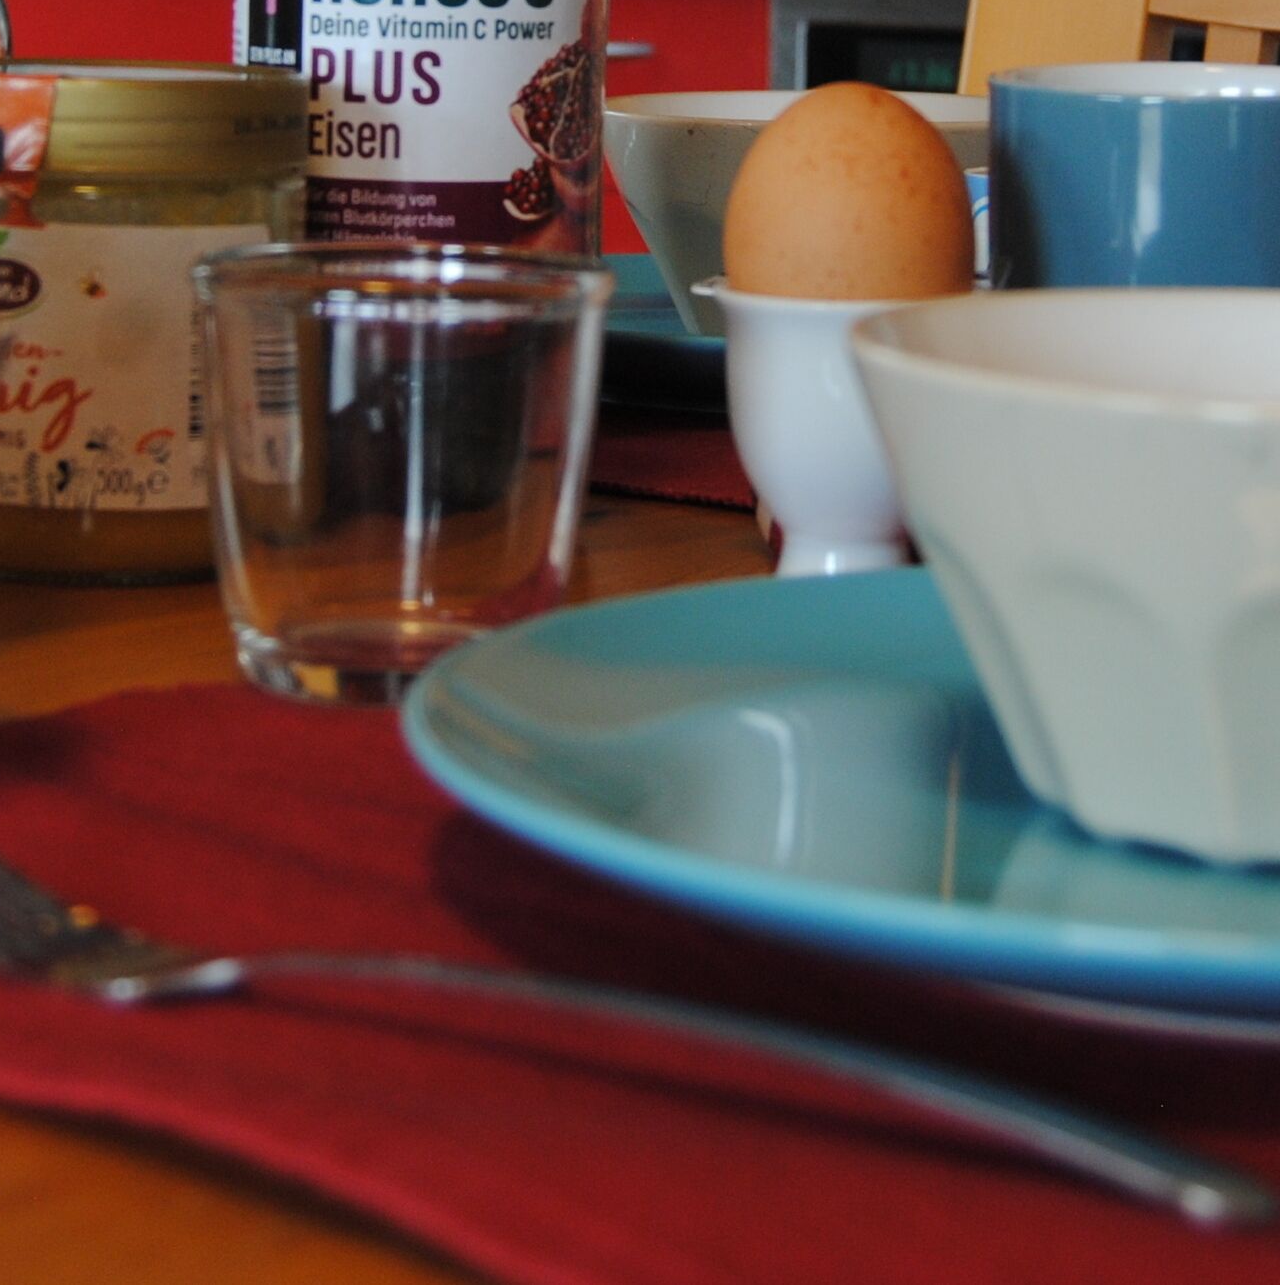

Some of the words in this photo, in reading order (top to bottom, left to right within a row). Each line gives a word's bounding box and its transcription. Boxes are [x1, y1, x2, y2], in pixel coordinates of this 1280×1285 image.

[310, 12, 370, 38] Deine
[378, 14, 468, 40] Vitamin
[474, 18, 487, 40] C
[494, 18, 556, 41] Power
[310, 47, 442, 106] PLUS
[307, 111, 401, 159] Eisen
[350, 188, 407, 211] Bildung
[408, 193, 438, 208] von
